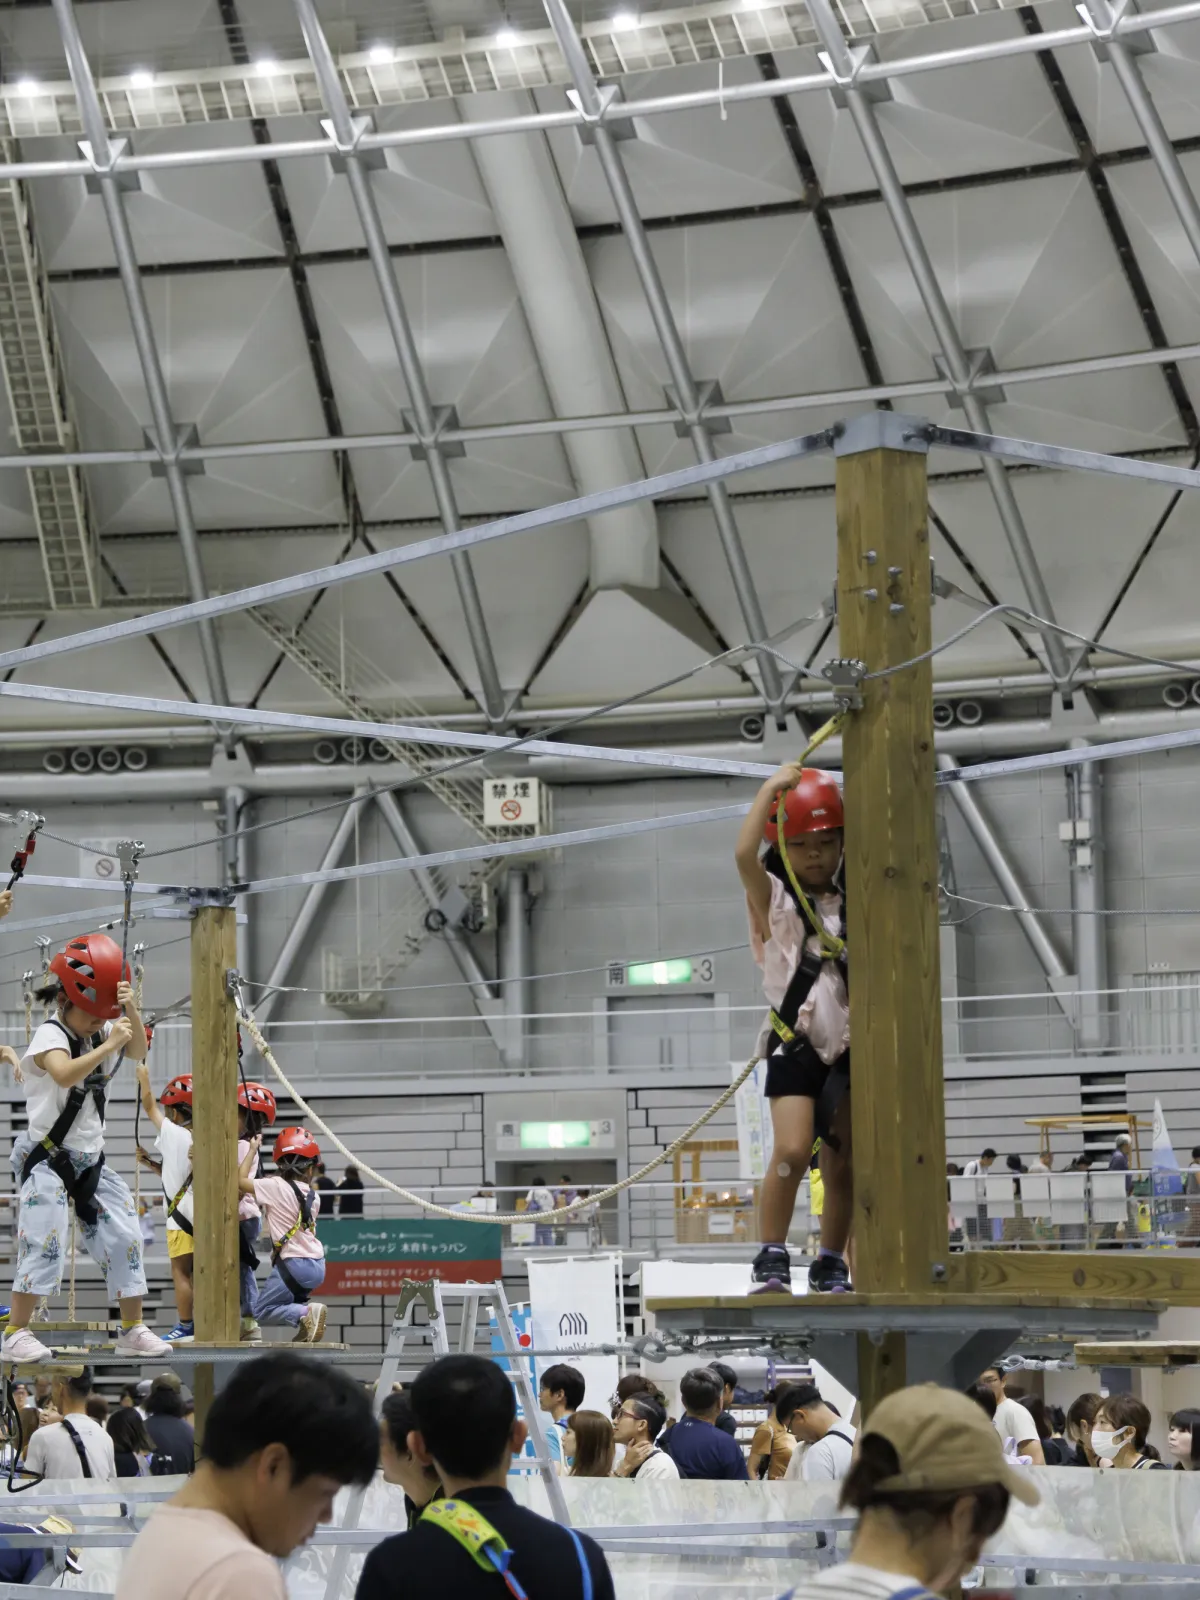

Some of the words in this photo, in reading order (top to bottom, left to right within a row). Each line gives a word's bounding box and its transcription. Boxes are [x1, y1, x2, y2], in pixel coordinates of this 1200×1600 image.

[492, 782, 530, 799] 禁煙
[608, 962, 624, 985] 南
[700, 959, 713, 982] 3
[602, 1121, 611, 1134] 3
